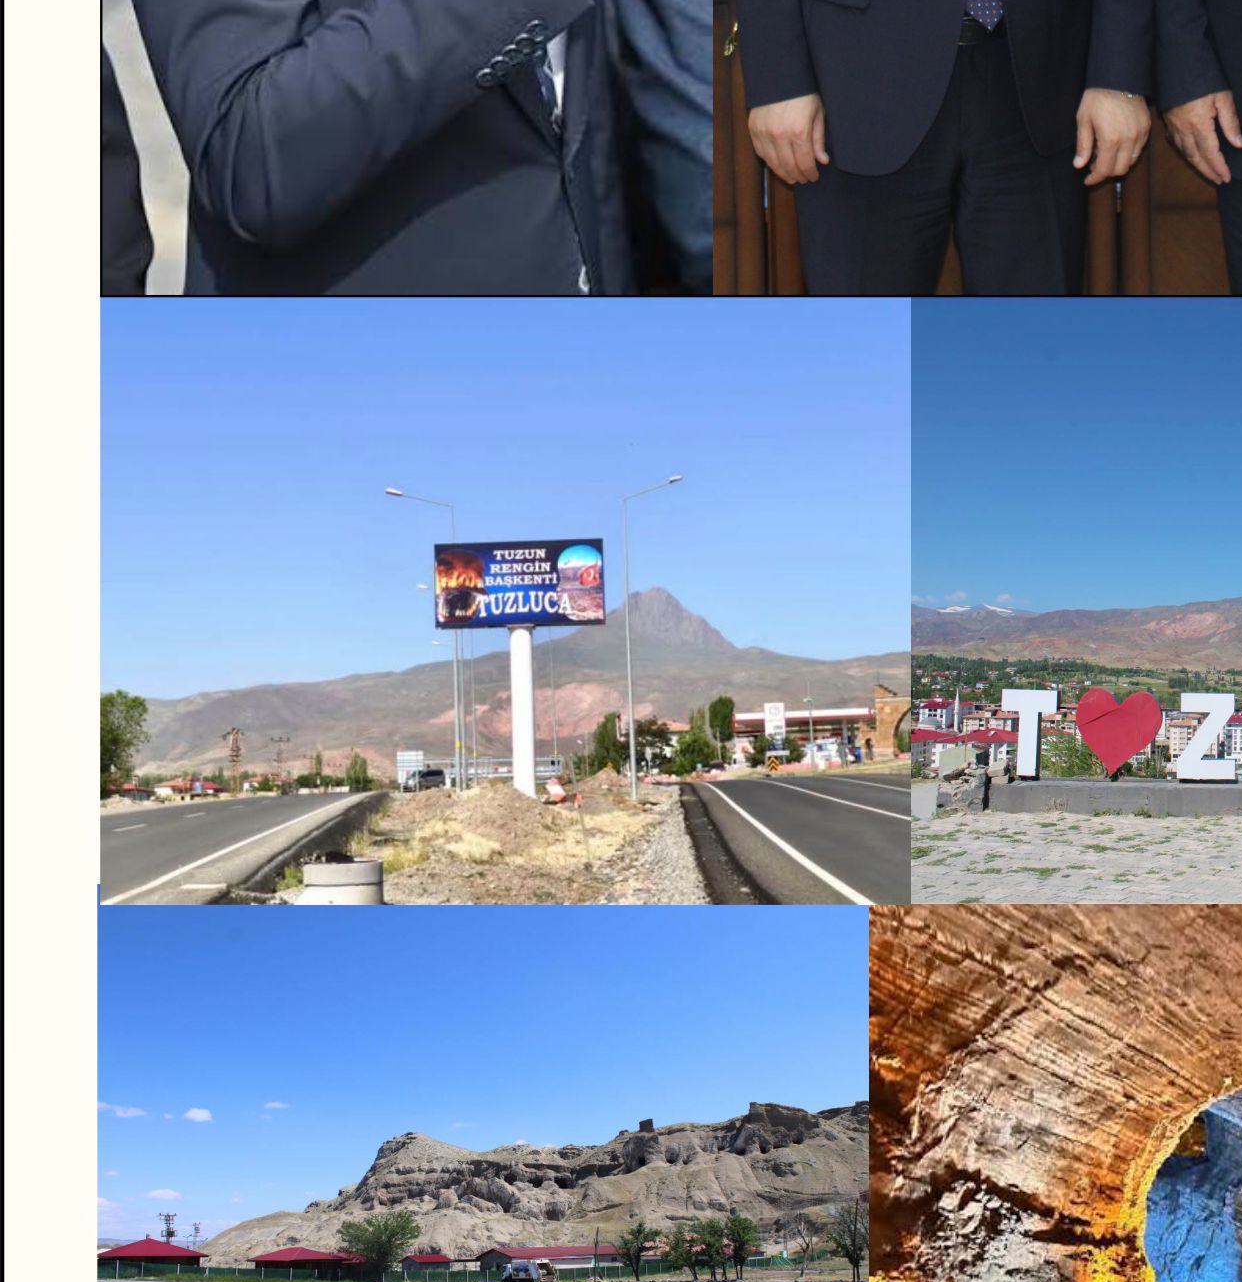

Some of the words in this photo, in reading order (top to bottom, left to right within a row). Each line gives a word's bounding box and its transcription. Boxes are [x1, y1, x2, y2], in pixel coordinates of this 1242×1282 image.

[493, 548, 546, 560] TUZUN
[490, 560, 551, 574] RENGİN
[485, 571, 558, 588] BAŞKENTİ
[476, 590, 573, 618] TUZLUCA
